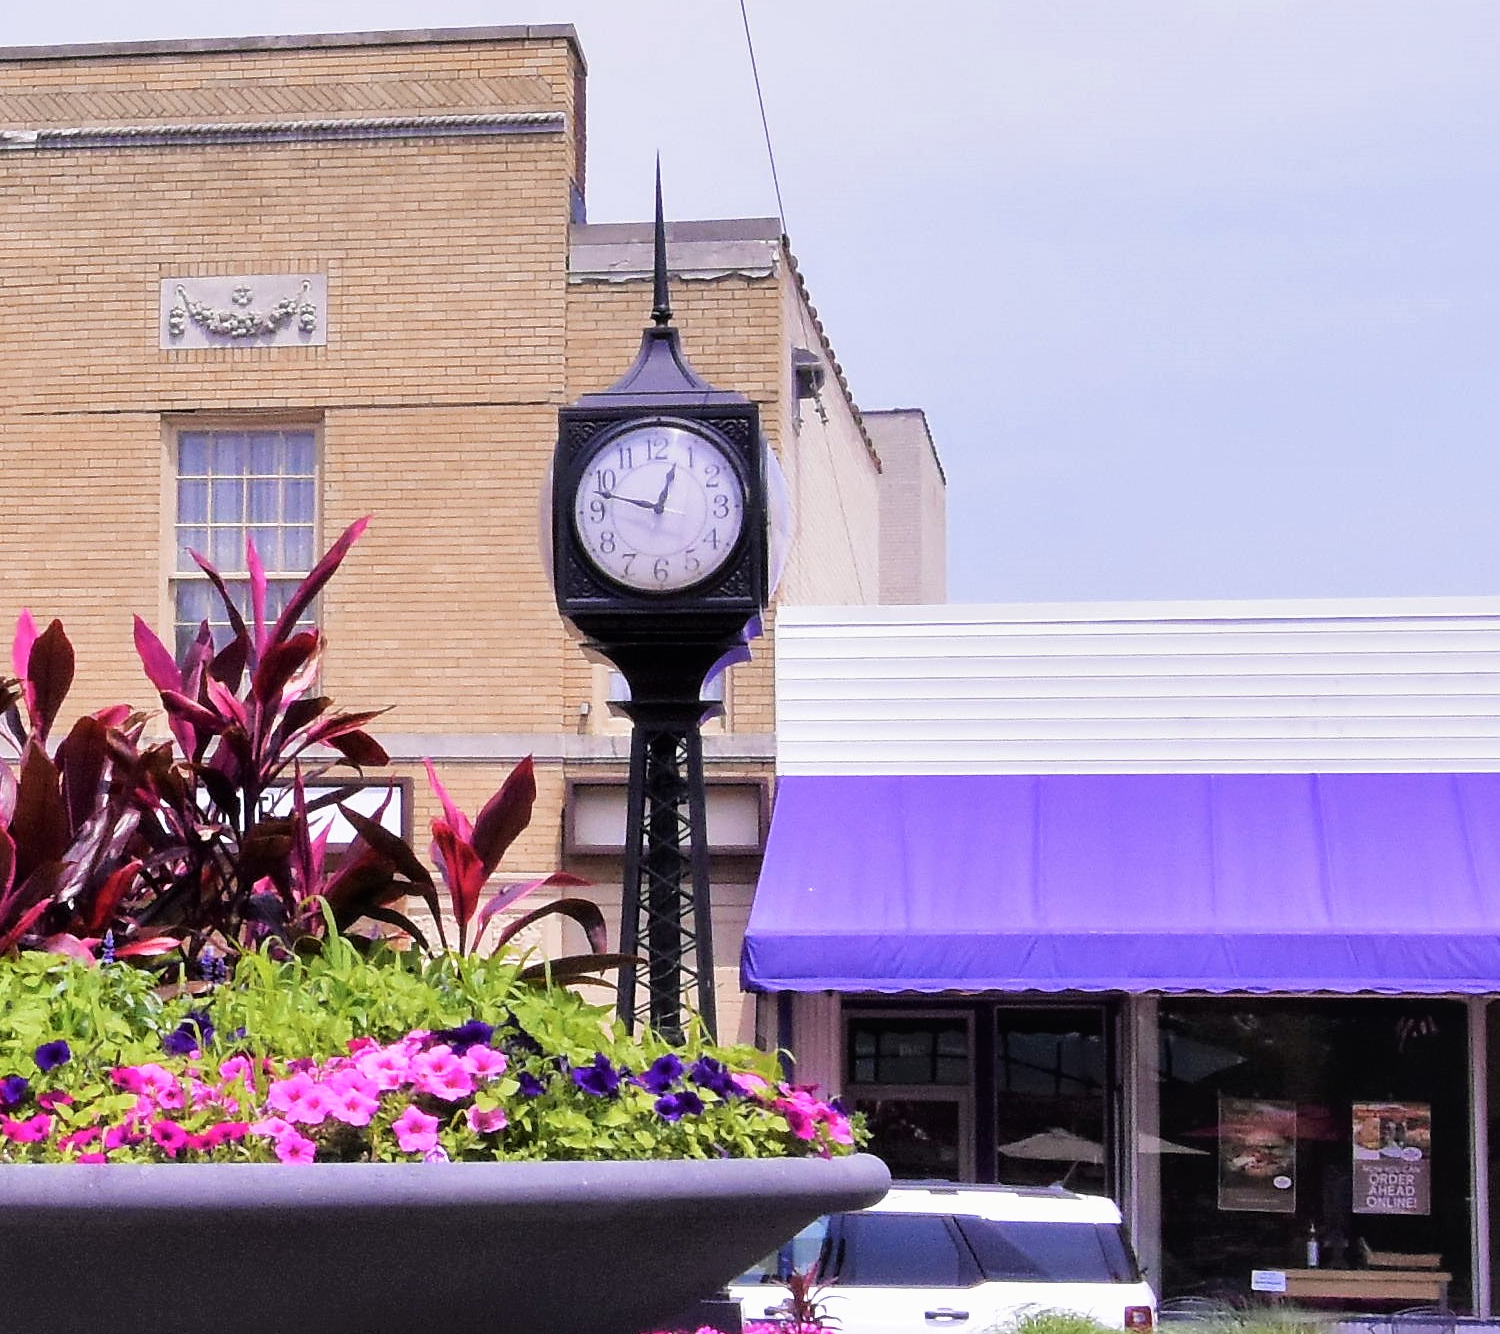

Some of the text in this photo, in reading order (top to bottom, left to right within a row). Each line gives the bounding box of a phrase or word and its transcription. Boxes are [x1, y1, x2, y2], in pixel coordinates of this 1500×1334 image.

[619, 446, 633, 468] 11
[646, 437, 669, 461] 12
[596, 468, 616, 493] 10
[704, 464, 720, 488] 2
[590, 499, 605, 524] 9
[713, 494, 729, 518] 3
[600, 530, 616, 553] 8
[703, 528, 721, 550] 4
[622, 553, 637, 578] 7
[653, 558, 669, 582] 6
[684, 548, 700, 572] 5
[1368, 1185, 1415, 1196] AHEAD
[1369, 1173, 1414, 1186] ORDER
[1366, 1196, 1417, 1208] ONLINE!
